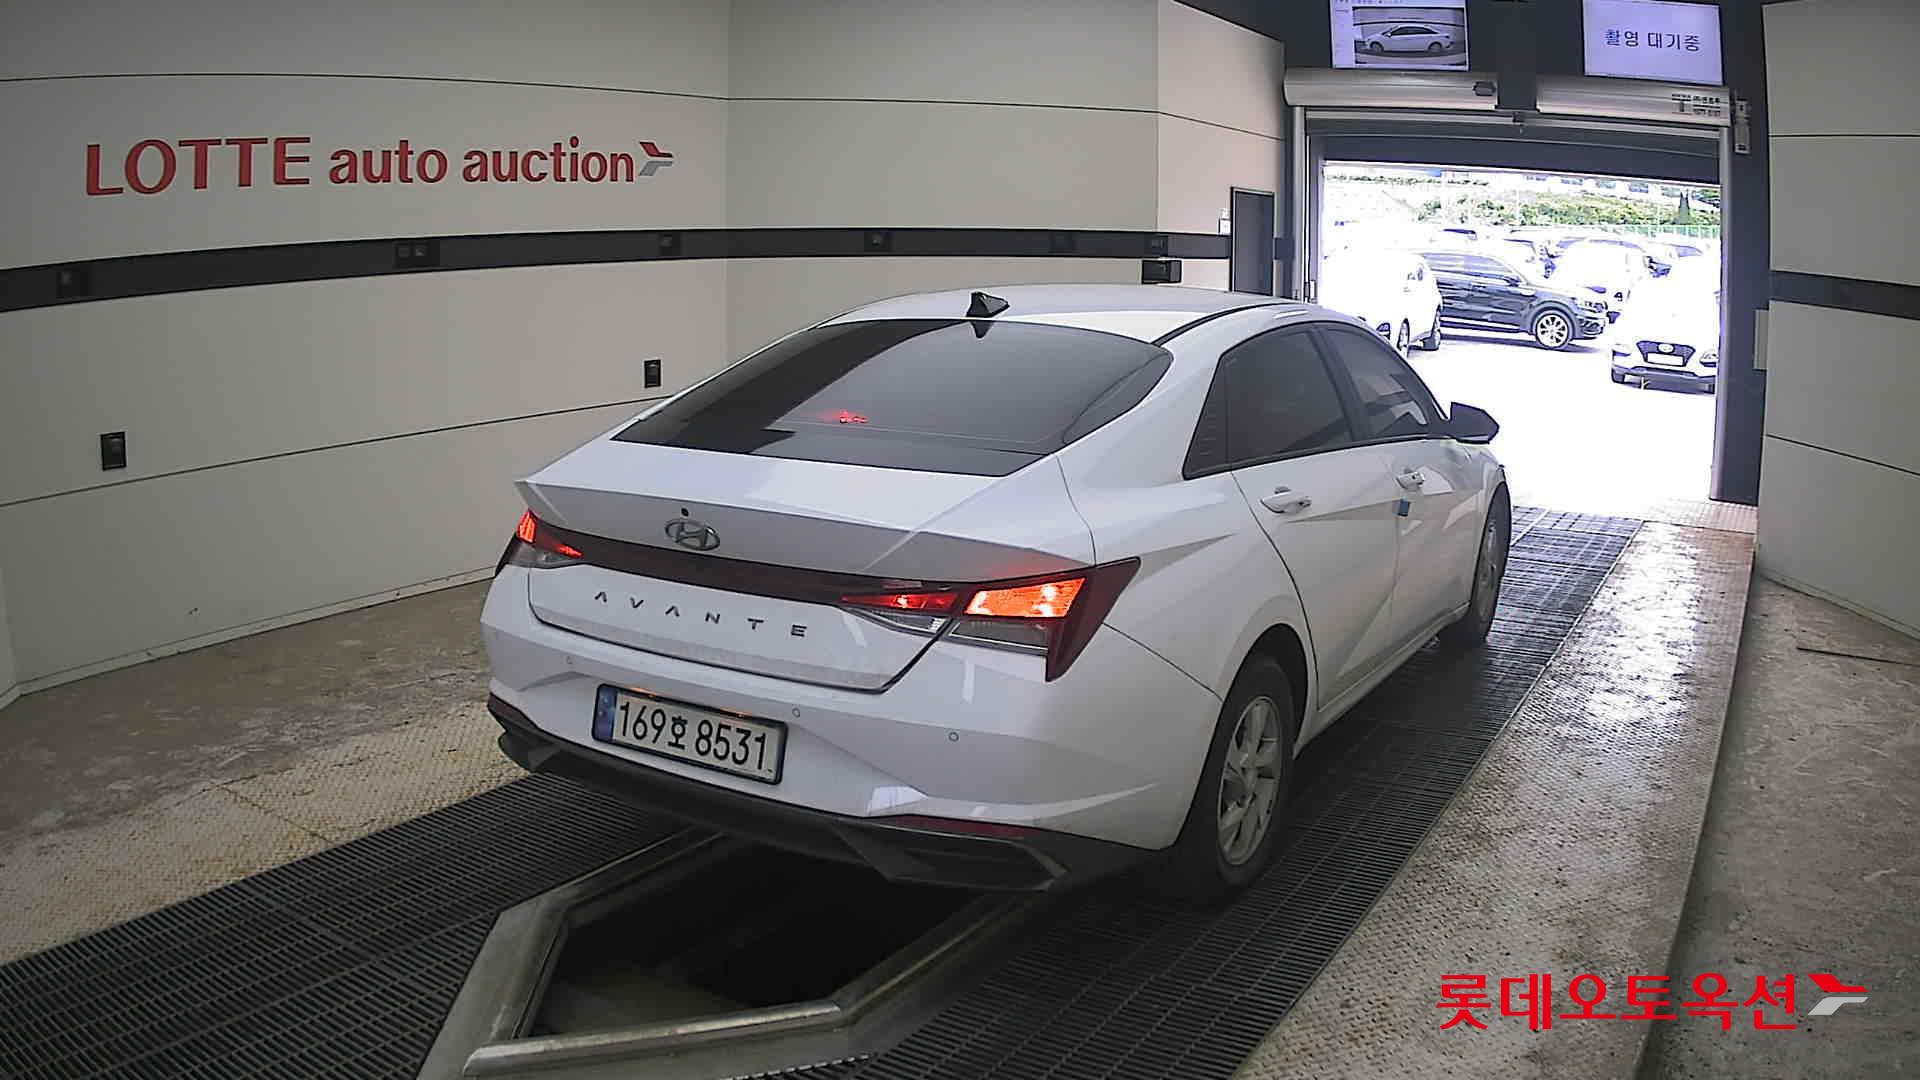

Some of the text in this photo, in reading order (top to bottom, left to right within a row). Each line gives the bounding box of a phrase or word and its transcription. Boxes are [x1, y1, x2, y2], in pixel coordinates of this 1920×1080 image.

[1647, 32, 1700, 52] 대기중
[86, 136, 635, 196] LOTTE auto auction
[595, 591, 807, 637] AVANTE
[620, 701, 767, 770] 169호 8531
